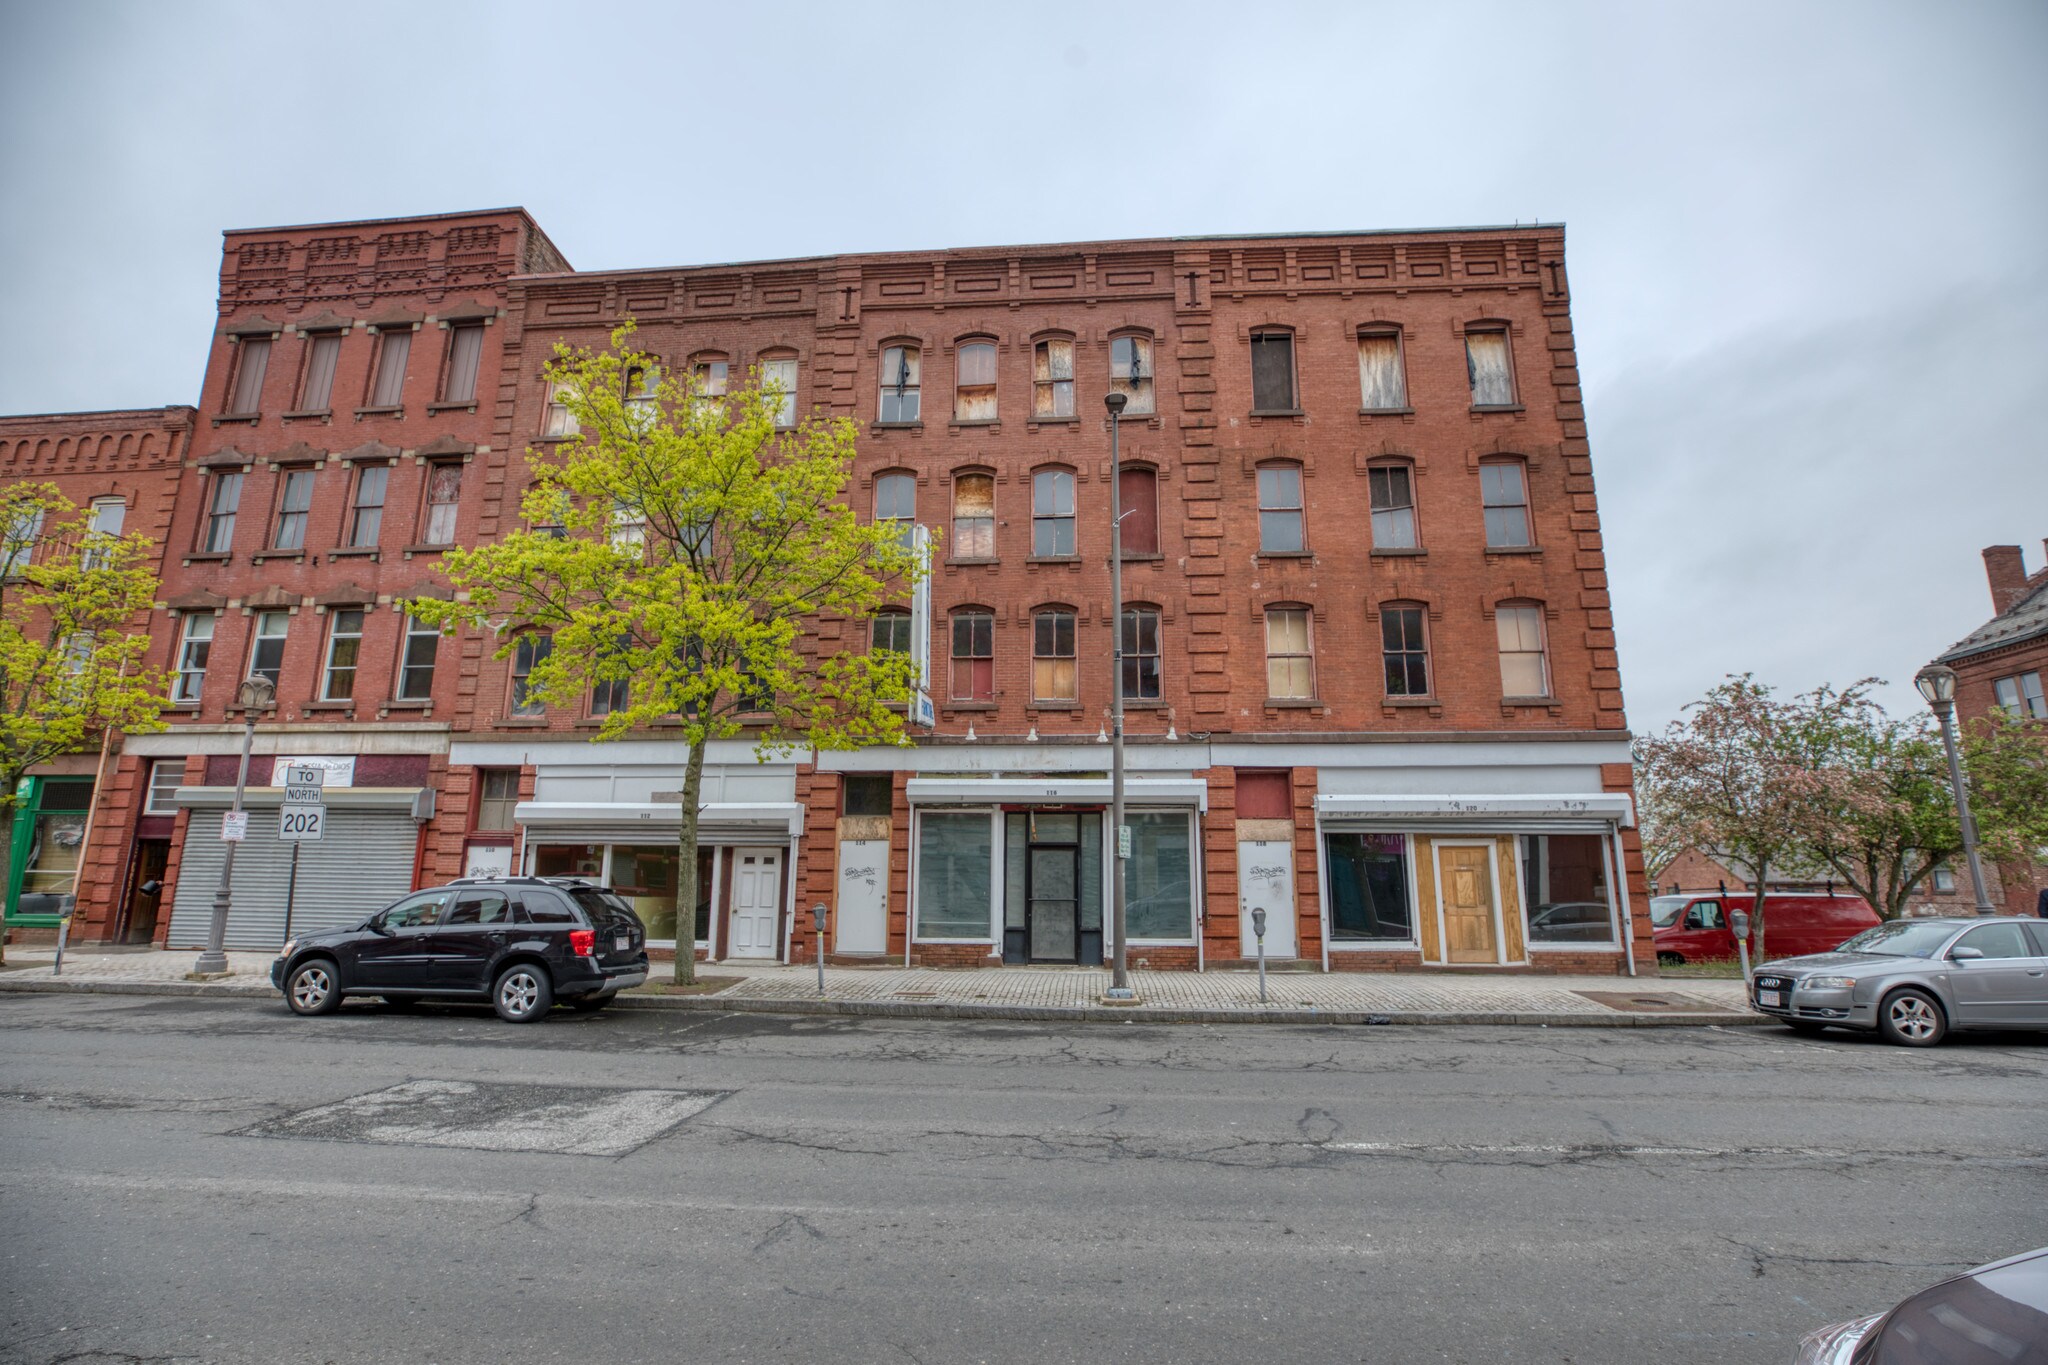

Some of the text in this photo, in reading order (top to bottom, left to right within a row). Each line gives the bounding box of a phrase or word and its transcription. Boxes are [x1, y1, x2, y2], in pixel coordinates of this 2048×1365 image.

[298, 772, 314, 782] TO
[288, 789, 318, 800] NORTH
[284, 814, 318, 832] 202
